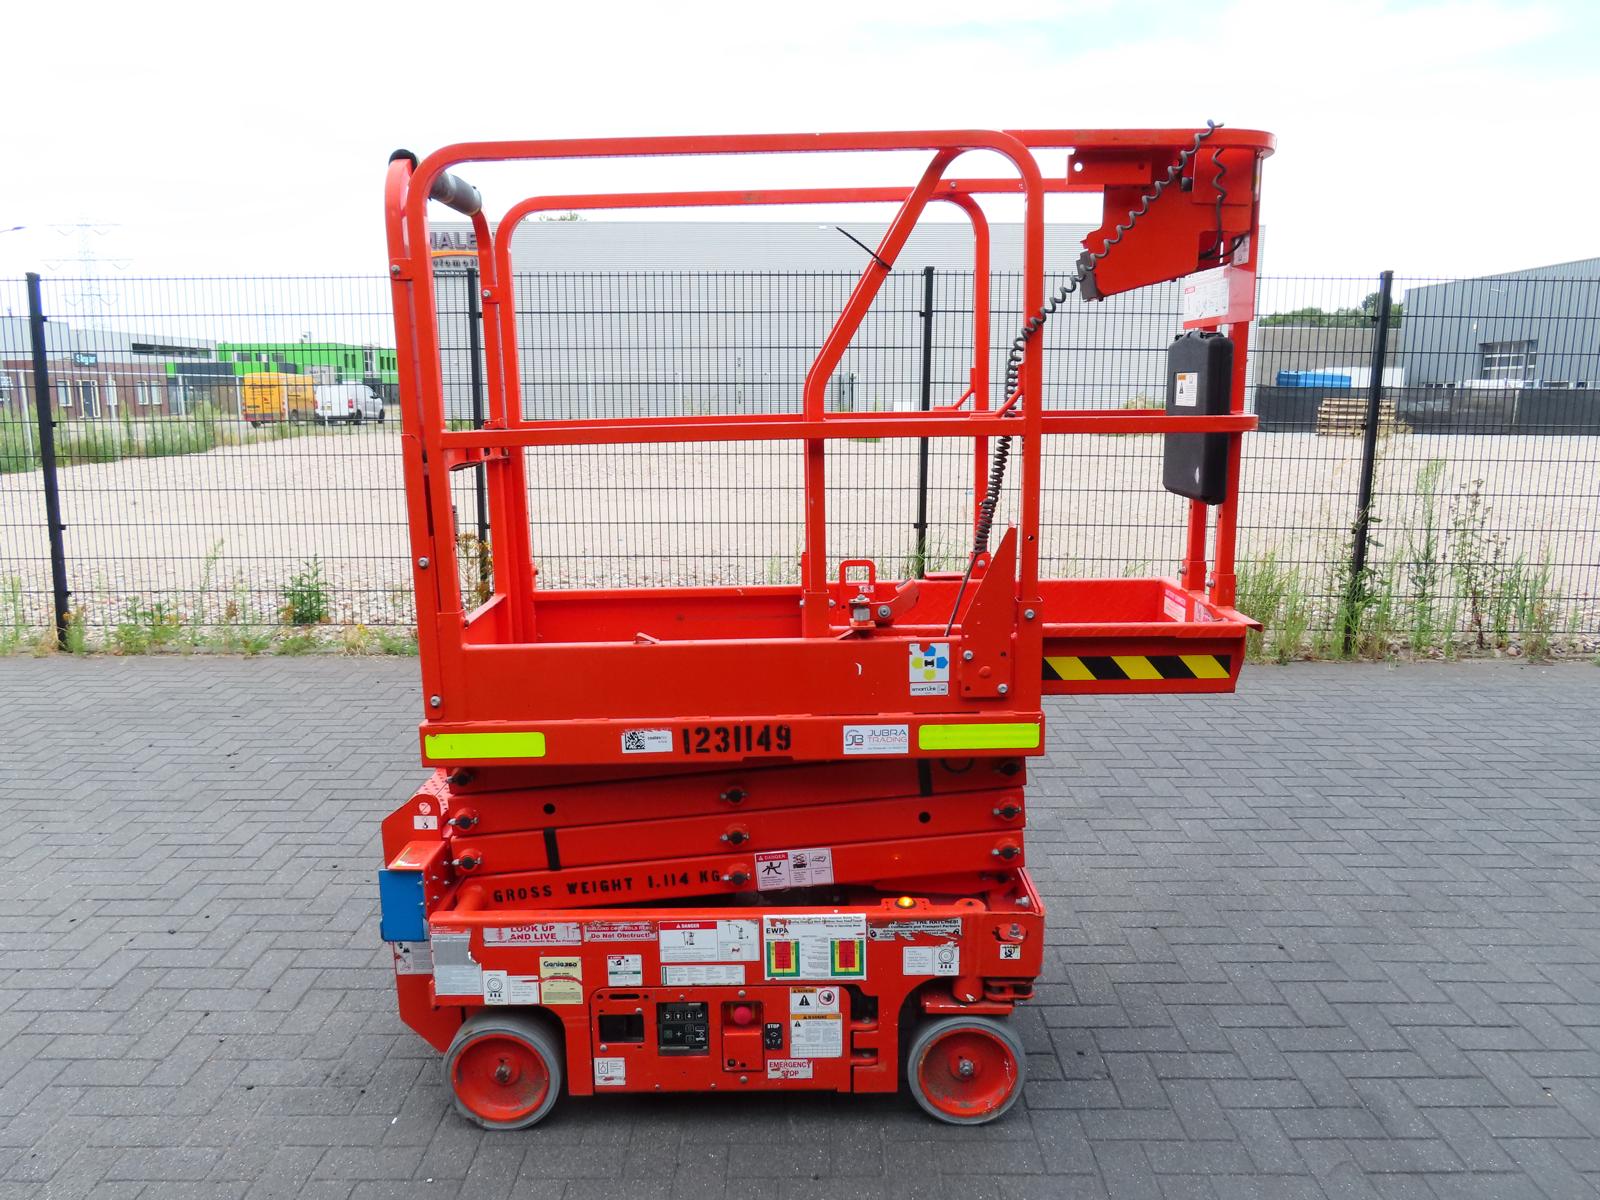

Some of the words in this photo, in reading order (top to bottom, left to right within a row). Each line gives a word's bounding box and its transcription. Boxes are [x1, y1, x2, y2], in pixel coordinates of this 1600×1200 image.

[429, 231, 478, 249] ALE
[682, 724, 792, 755] 1231149
[867, 728, 907, 737] JUBRA
[493, 884, 553, 903] GROSS
[566, 877, 634, 895] WEIGHT
[700, 869, 721, 883] KG
[533, 932, 557, 940] LIVE
